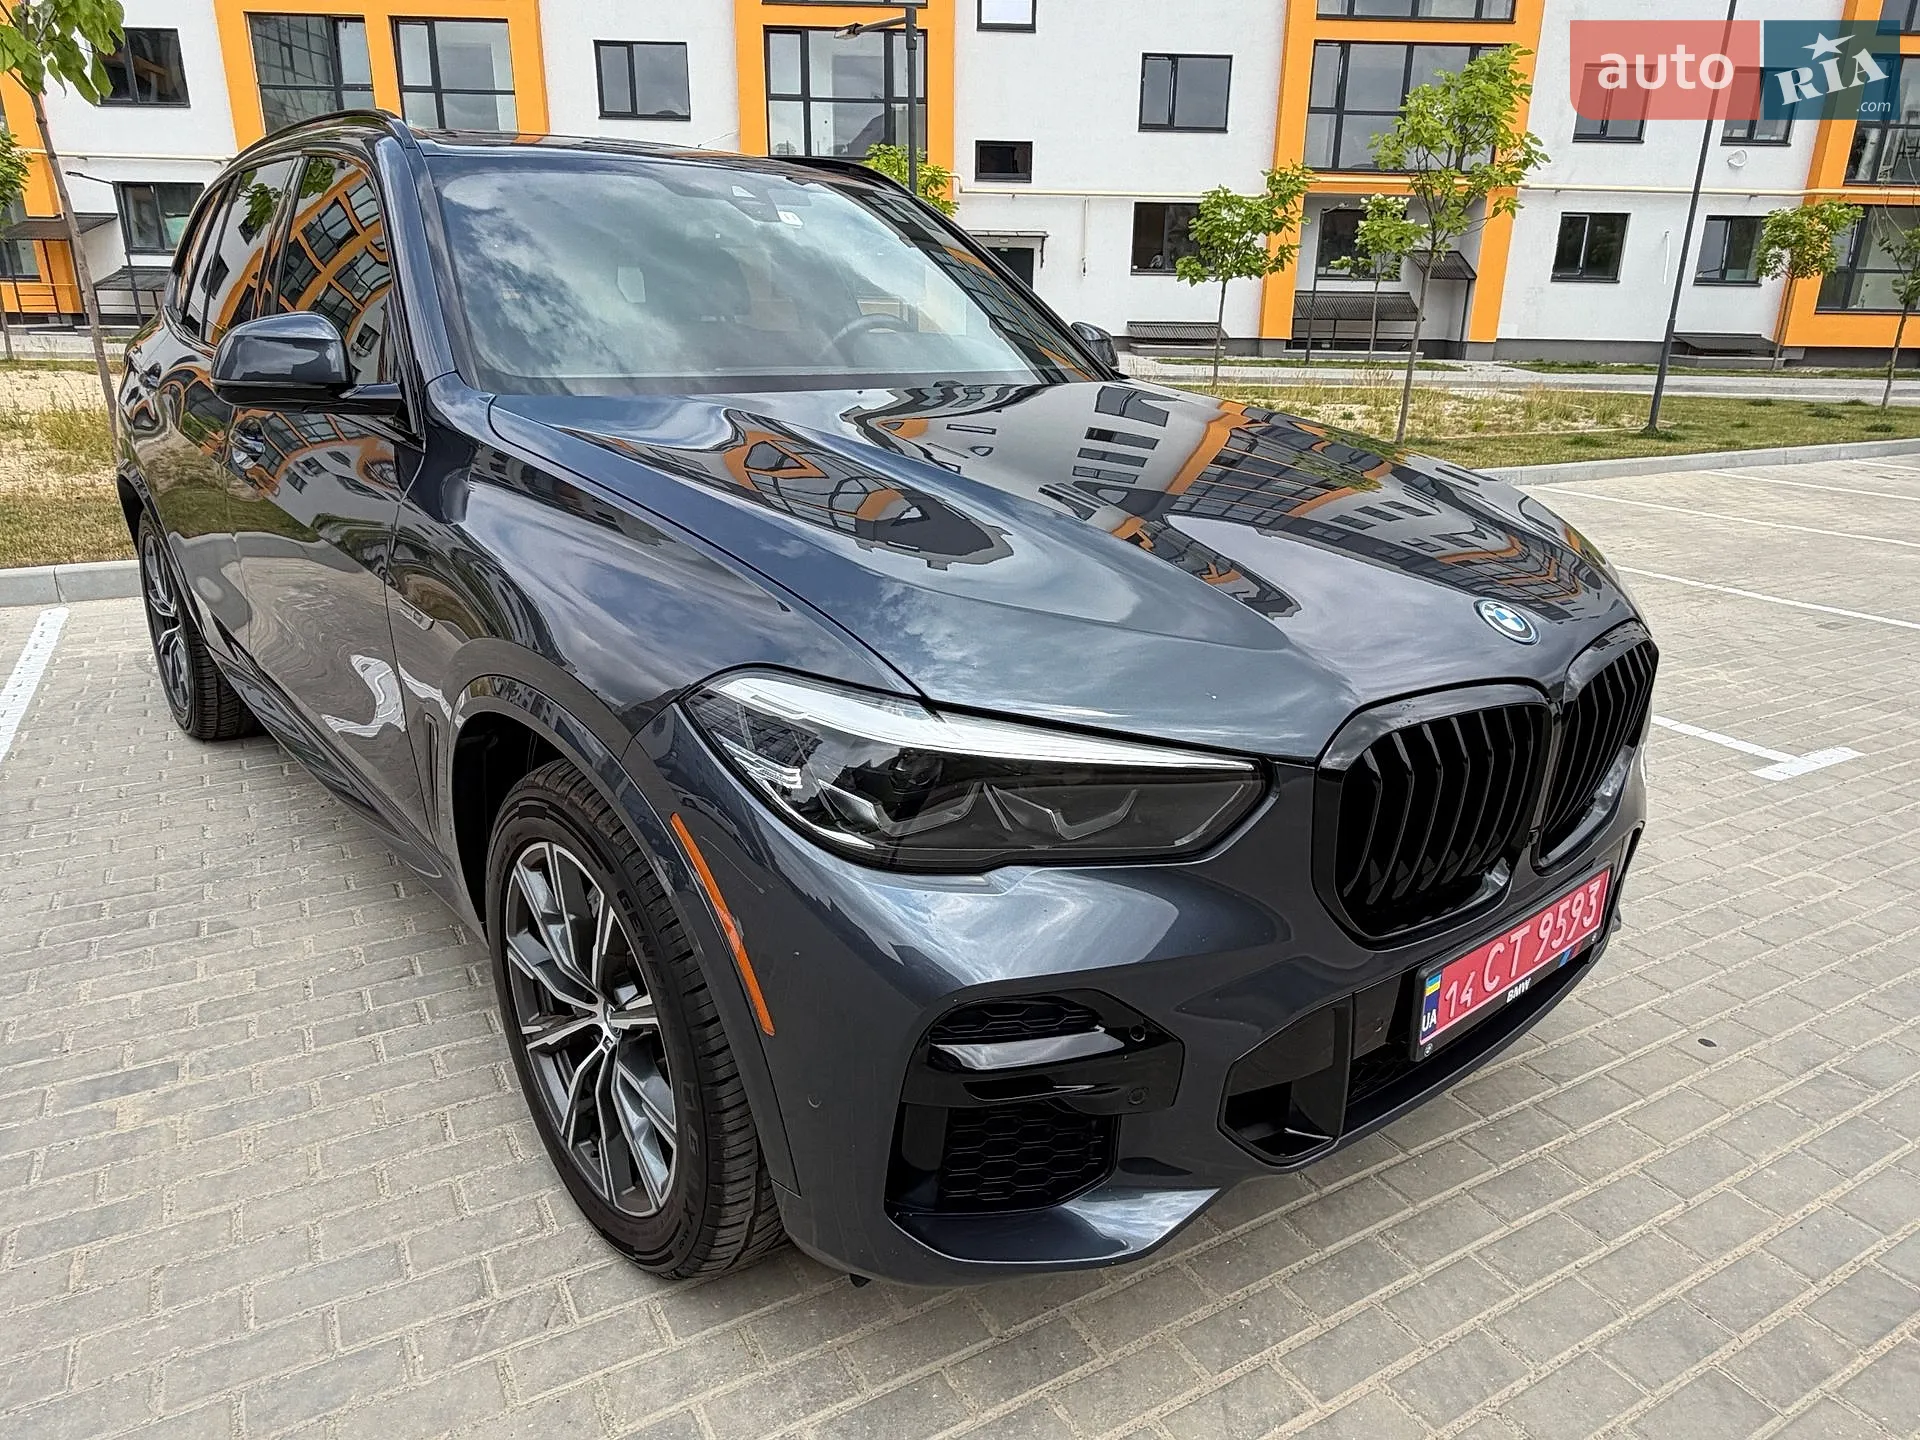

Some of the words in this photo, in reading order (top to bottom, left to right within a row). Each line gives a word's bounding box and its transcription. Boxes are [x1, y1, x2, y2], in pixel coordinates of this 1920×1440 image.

[1445, 970, 1476, 1019] 14
[1483, 925, 1532, 993] CT
[1533, 879, 1603, 963] 9593
[1506, 977, 1532, 1003] BMW
[1421, 1008, 1437, 1032] UA
